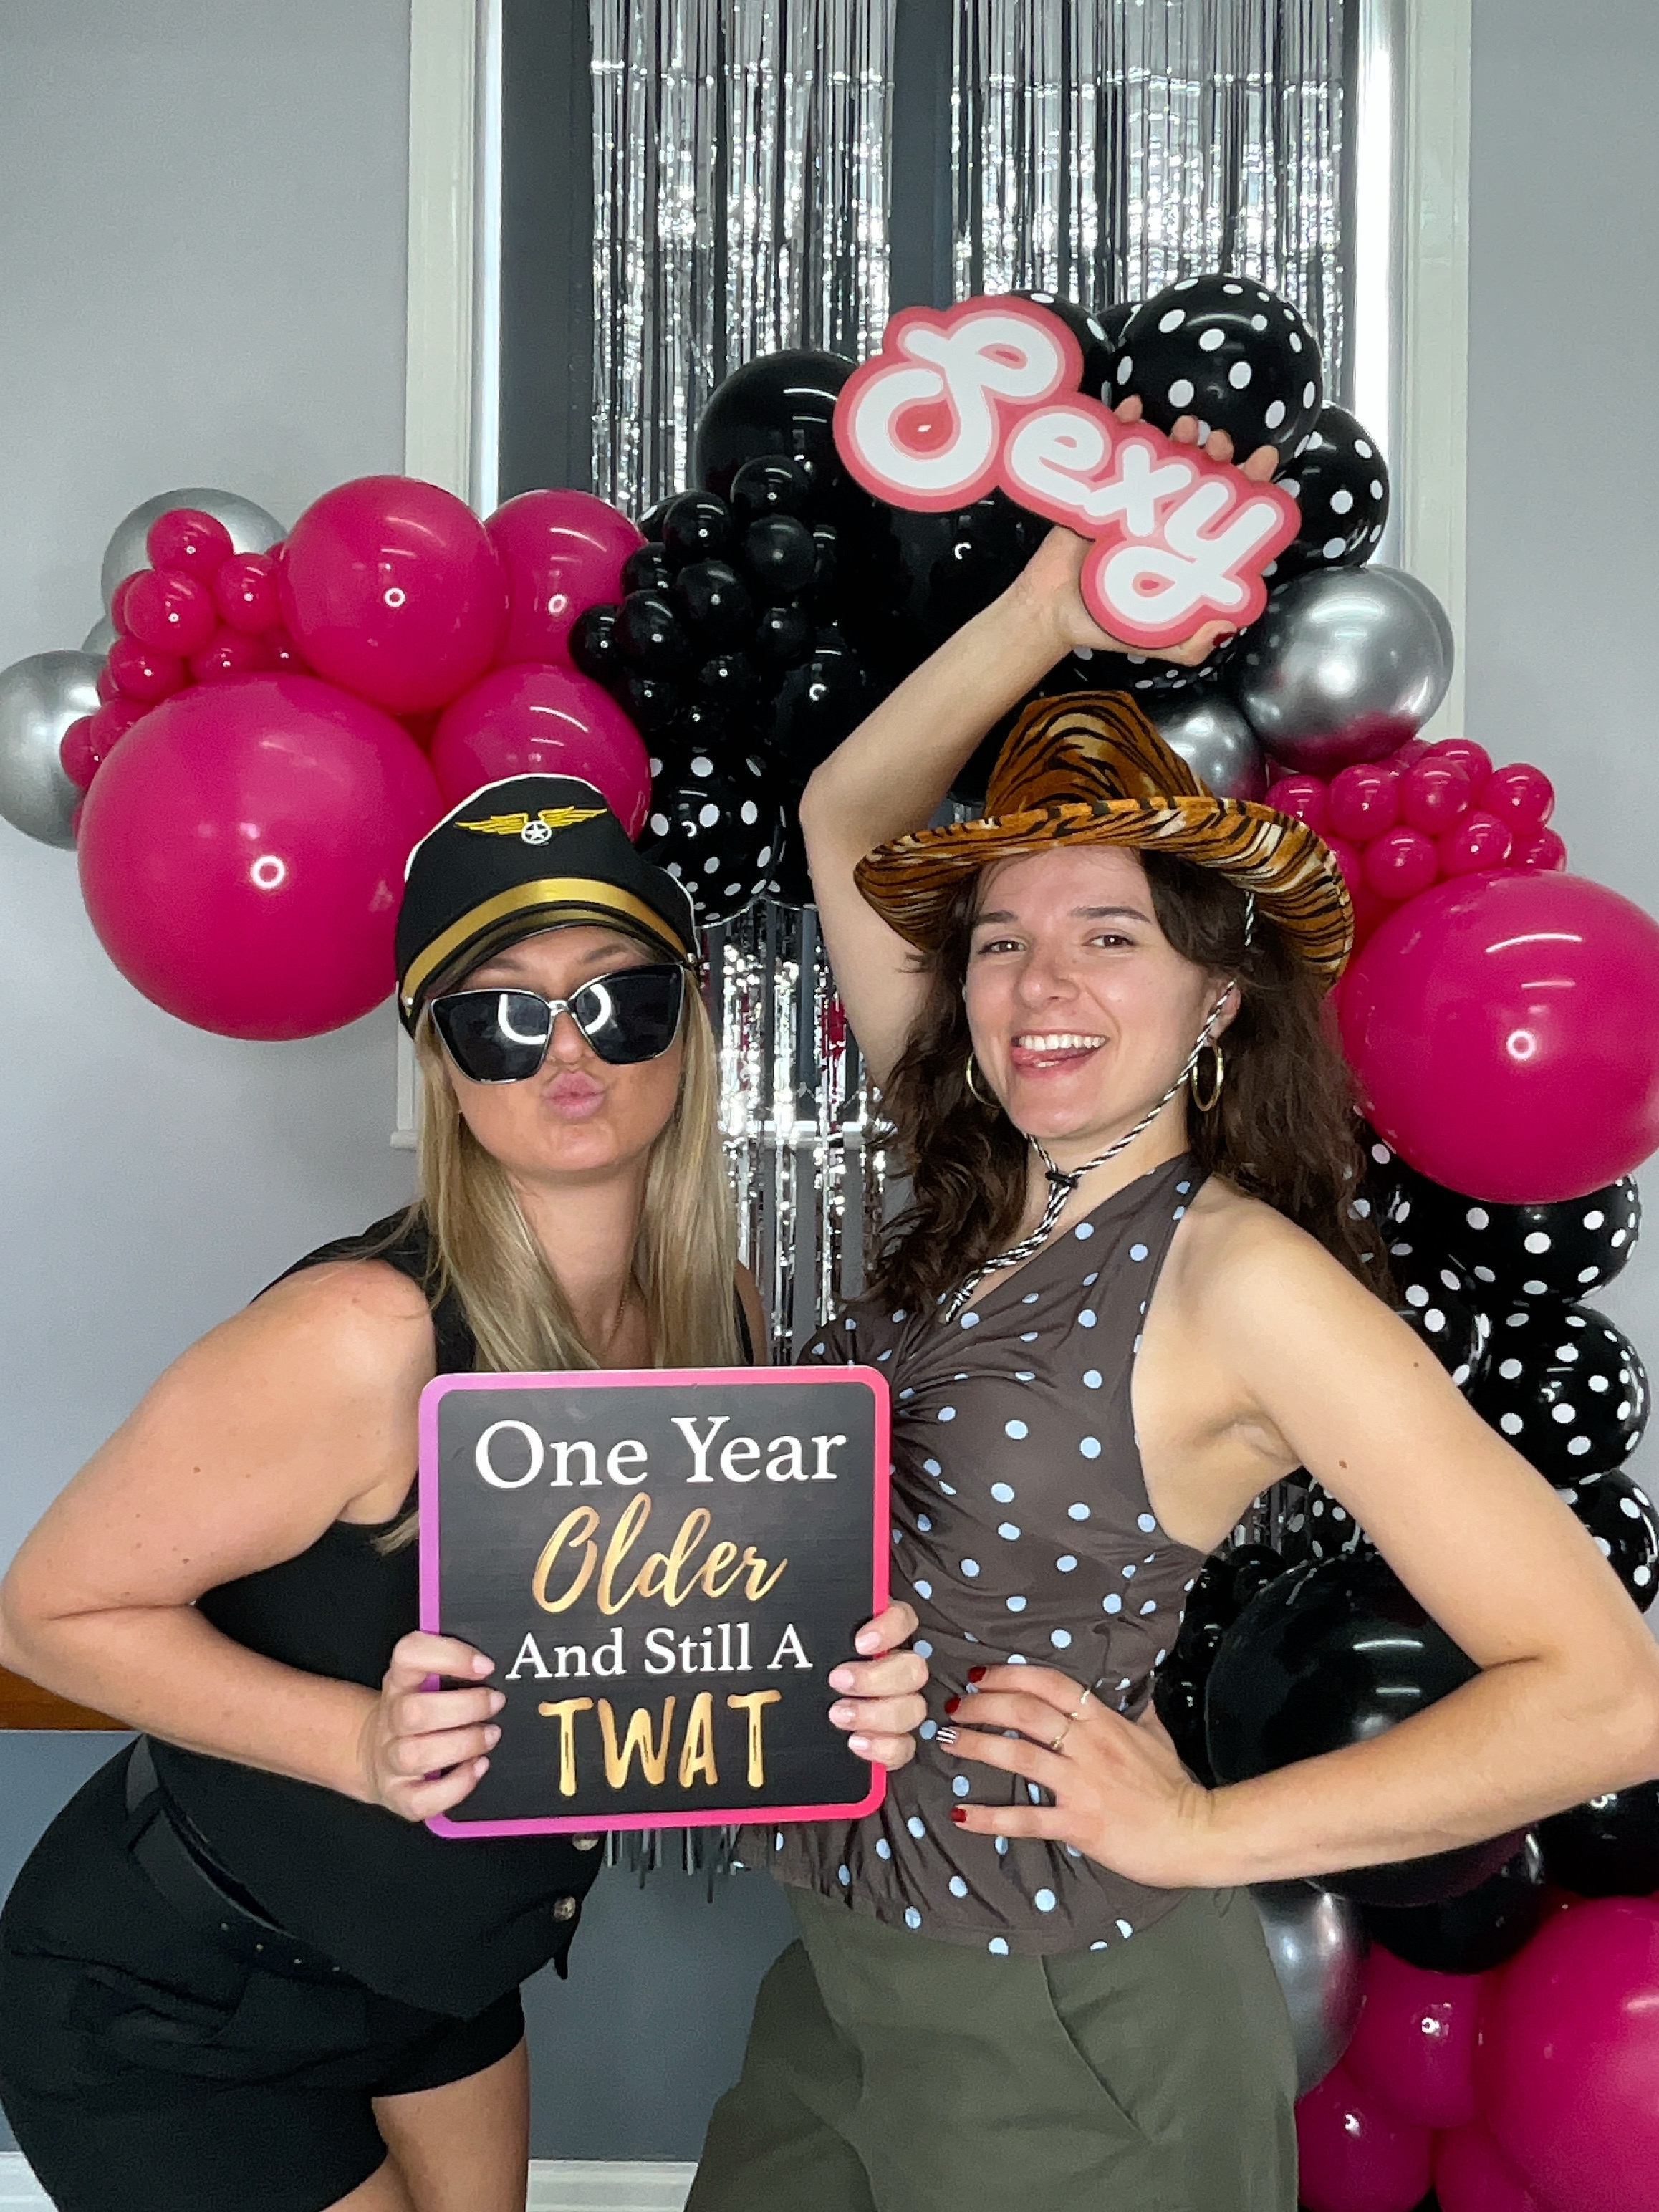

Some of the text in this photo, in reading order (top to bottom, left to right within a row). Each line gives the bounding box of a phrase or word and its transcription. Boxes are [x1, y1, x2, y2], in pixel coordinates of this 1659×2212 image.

[854, 315, 1278, 623] Sexy
[475, 1415, 847, 1489] One Year
[532, 1491, 788, 1615] Older
[504, 1622, 813, 1680] And Still A
[537, 1689, 782, 1797] TWAT
